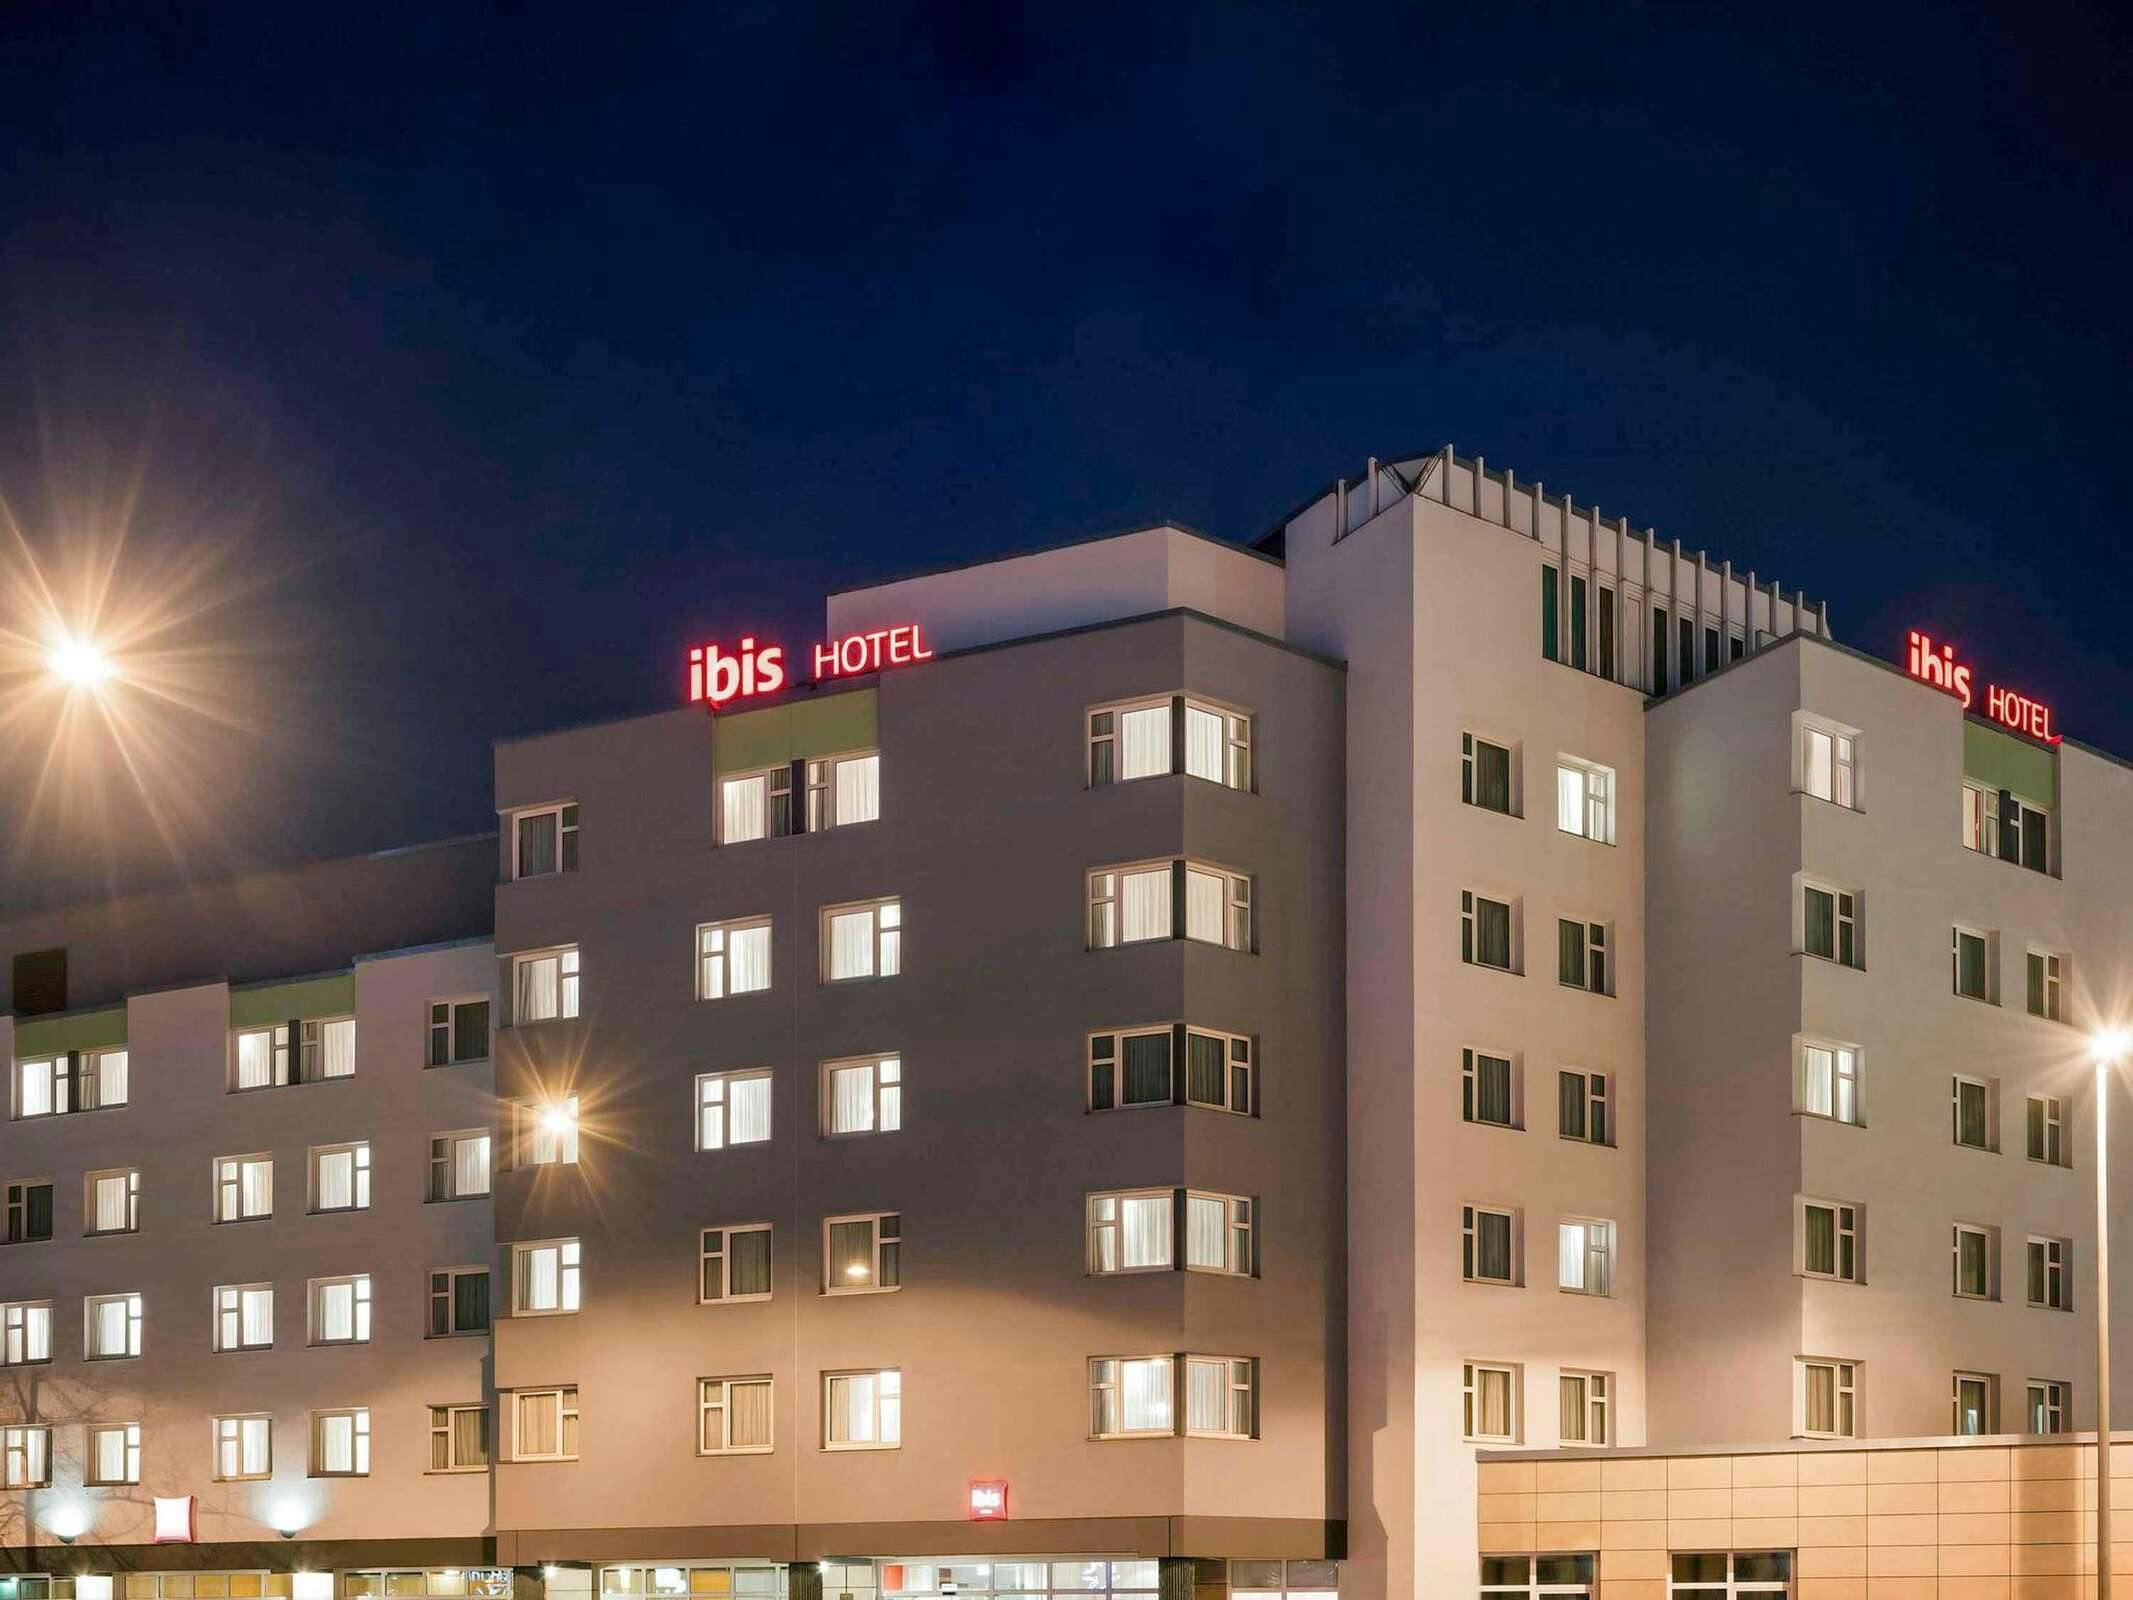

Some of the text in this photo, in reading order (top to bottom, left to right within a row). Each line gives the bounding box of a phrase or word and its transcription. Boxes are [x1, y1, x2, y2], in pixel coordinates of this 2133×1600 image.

[690, 624, 932, 702] ibis HOTEL
[1989, 684, 2061, 743] HOTEL
